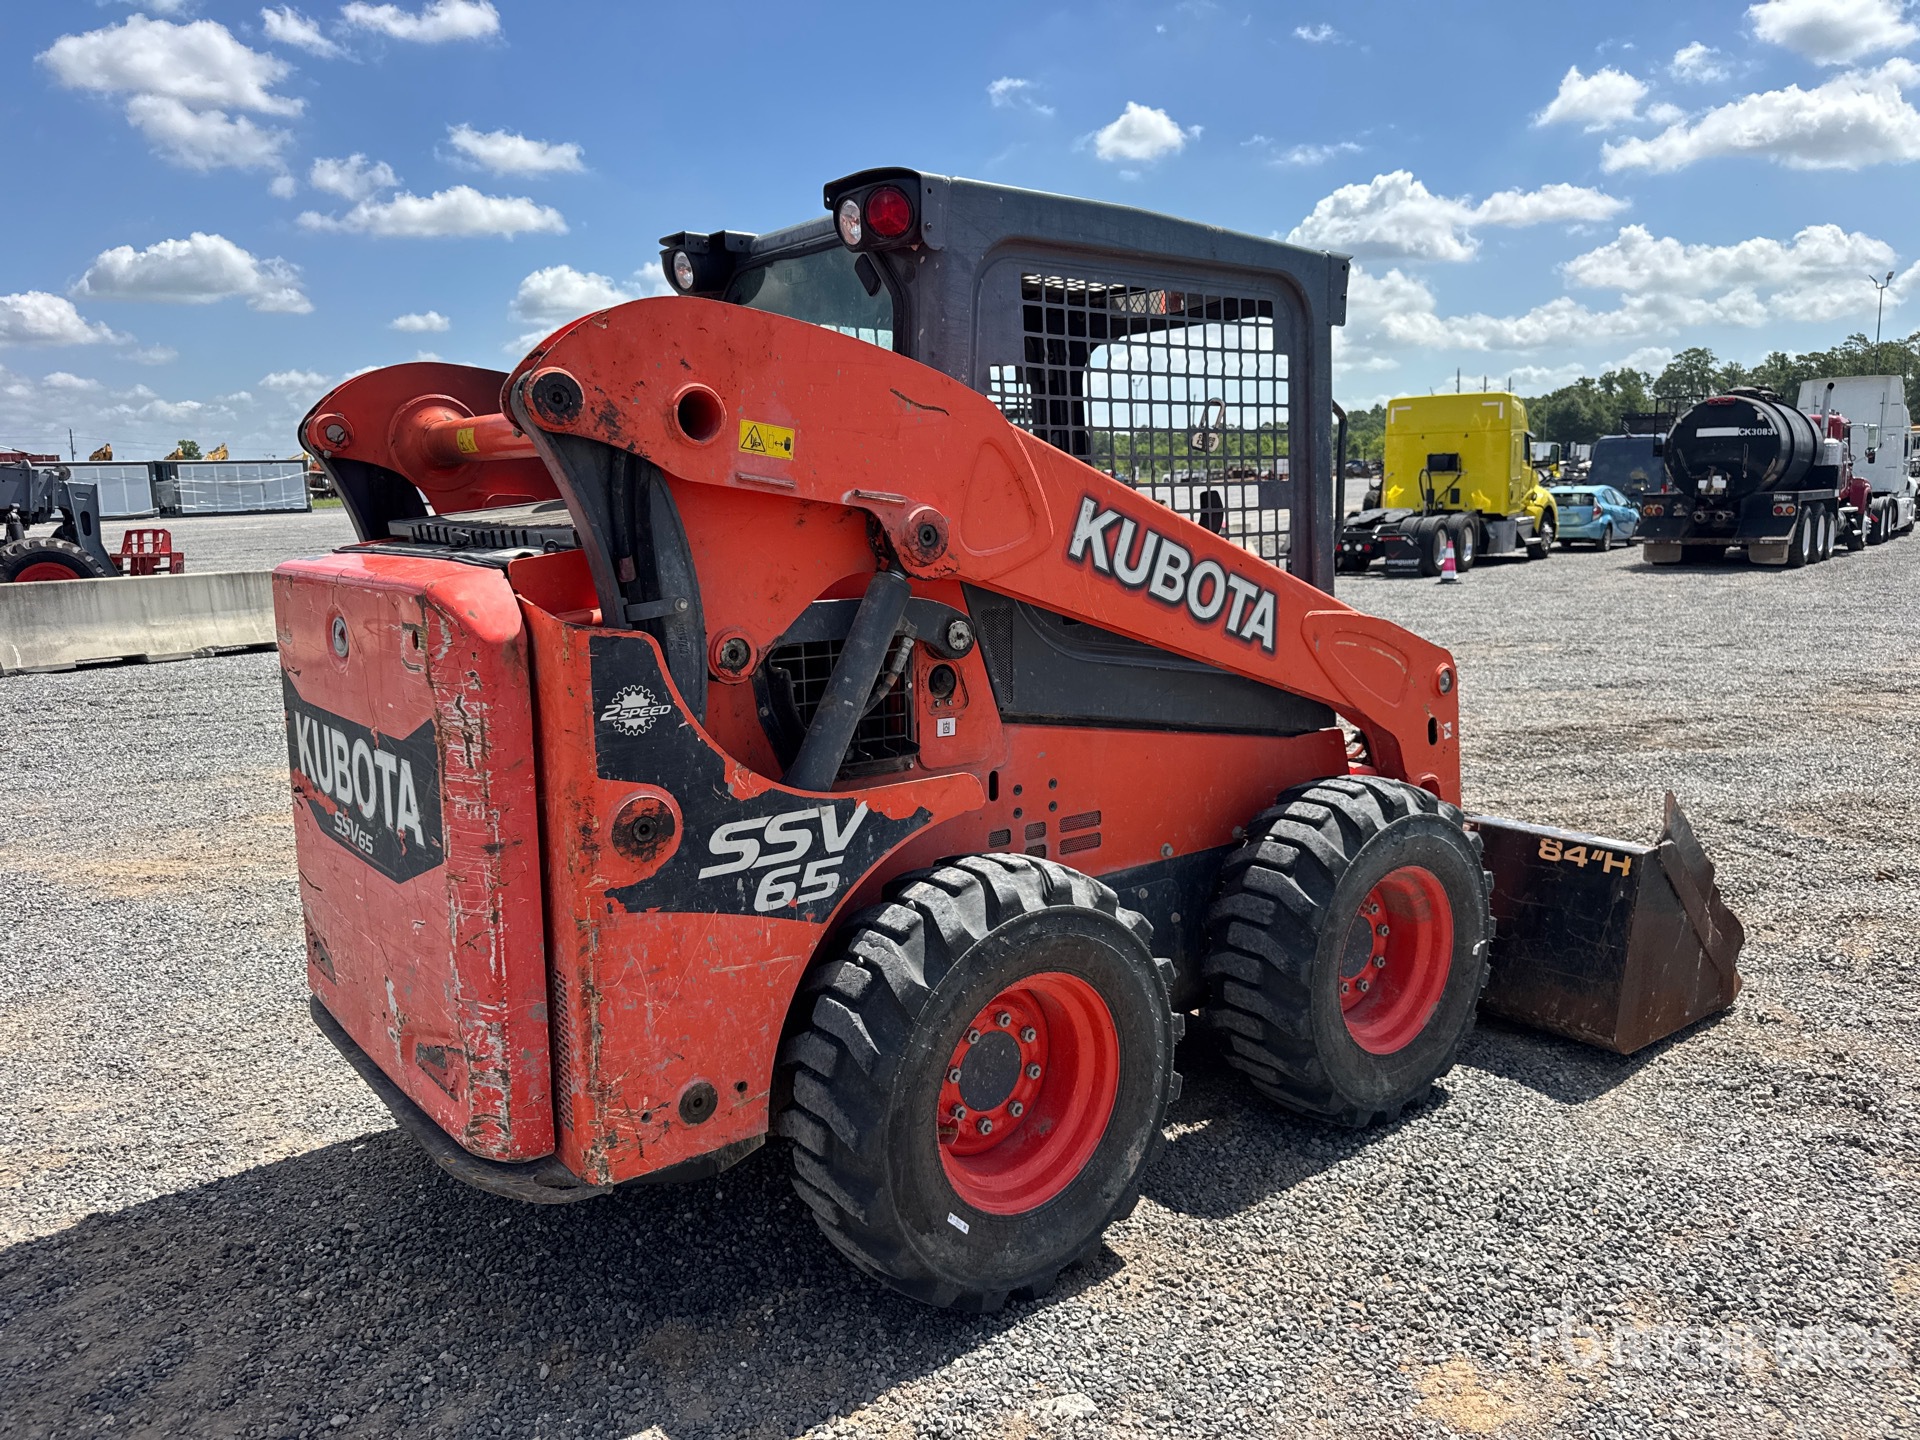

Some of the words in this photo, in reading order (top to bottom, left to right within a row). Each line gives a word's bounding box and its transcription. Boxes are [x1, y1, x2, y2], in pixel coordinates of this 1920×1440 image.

[1738, 427, 1773, 436] CK3083
[1068, 496, 1277, 650] KUBOTA
[294, 711, 426, 848] KUBOTA
[698, 800, 869, 880] SSV
[754, 855, 844, 912] 65
